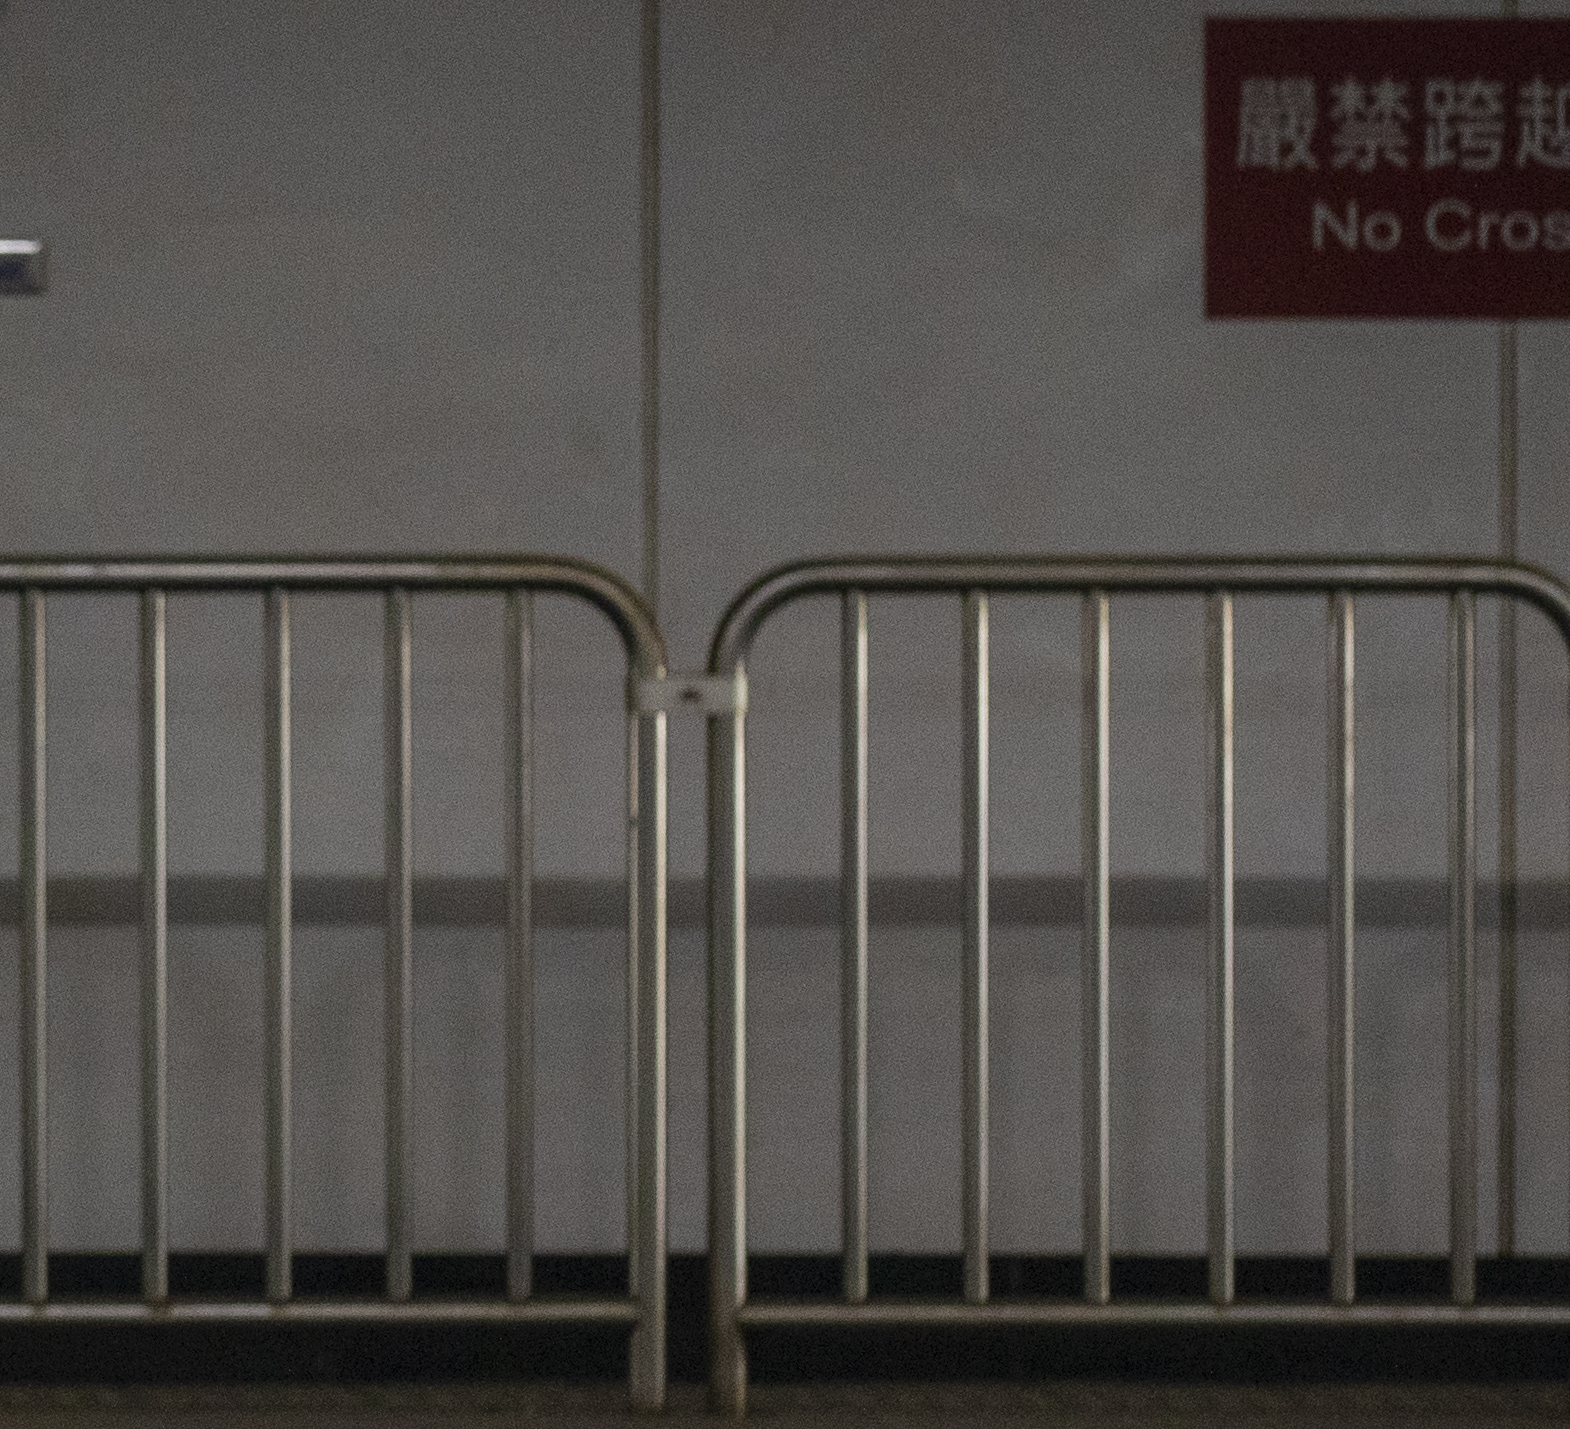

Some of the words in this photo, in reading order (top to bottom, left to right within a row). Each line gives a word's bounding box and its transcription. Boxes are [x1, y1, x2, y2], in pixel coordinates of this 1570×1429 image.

[1237, 75, 1570, 172] 嚴禁跨越
[1311, 197, 1402, 252] No
